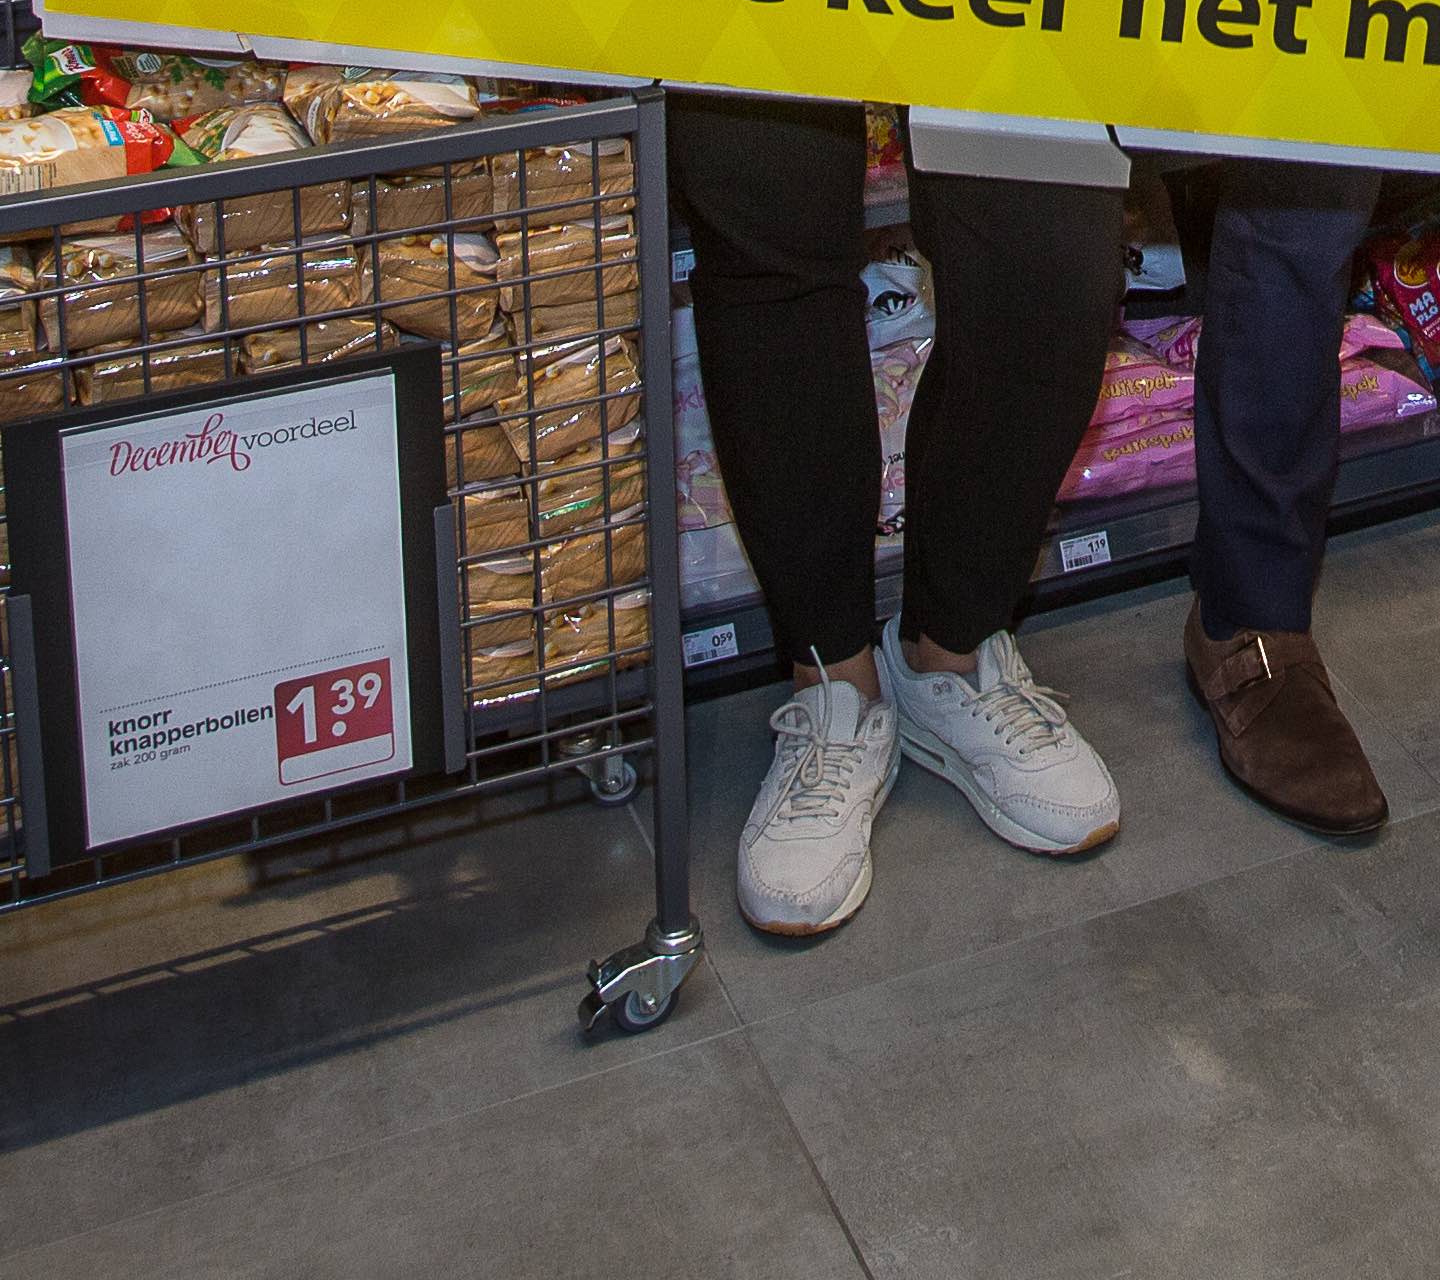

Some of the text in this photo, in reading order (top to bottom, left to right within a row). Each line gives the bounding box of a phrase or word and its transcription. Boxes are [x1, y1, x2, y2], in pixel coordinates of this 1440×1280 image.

[108, 408, 359, 479] December voordeel
[107, 705, 174, 739] knorr
[109, 702, 275, 758] knapperbollen
[110, 743, 193, 771] zak 200 gram
